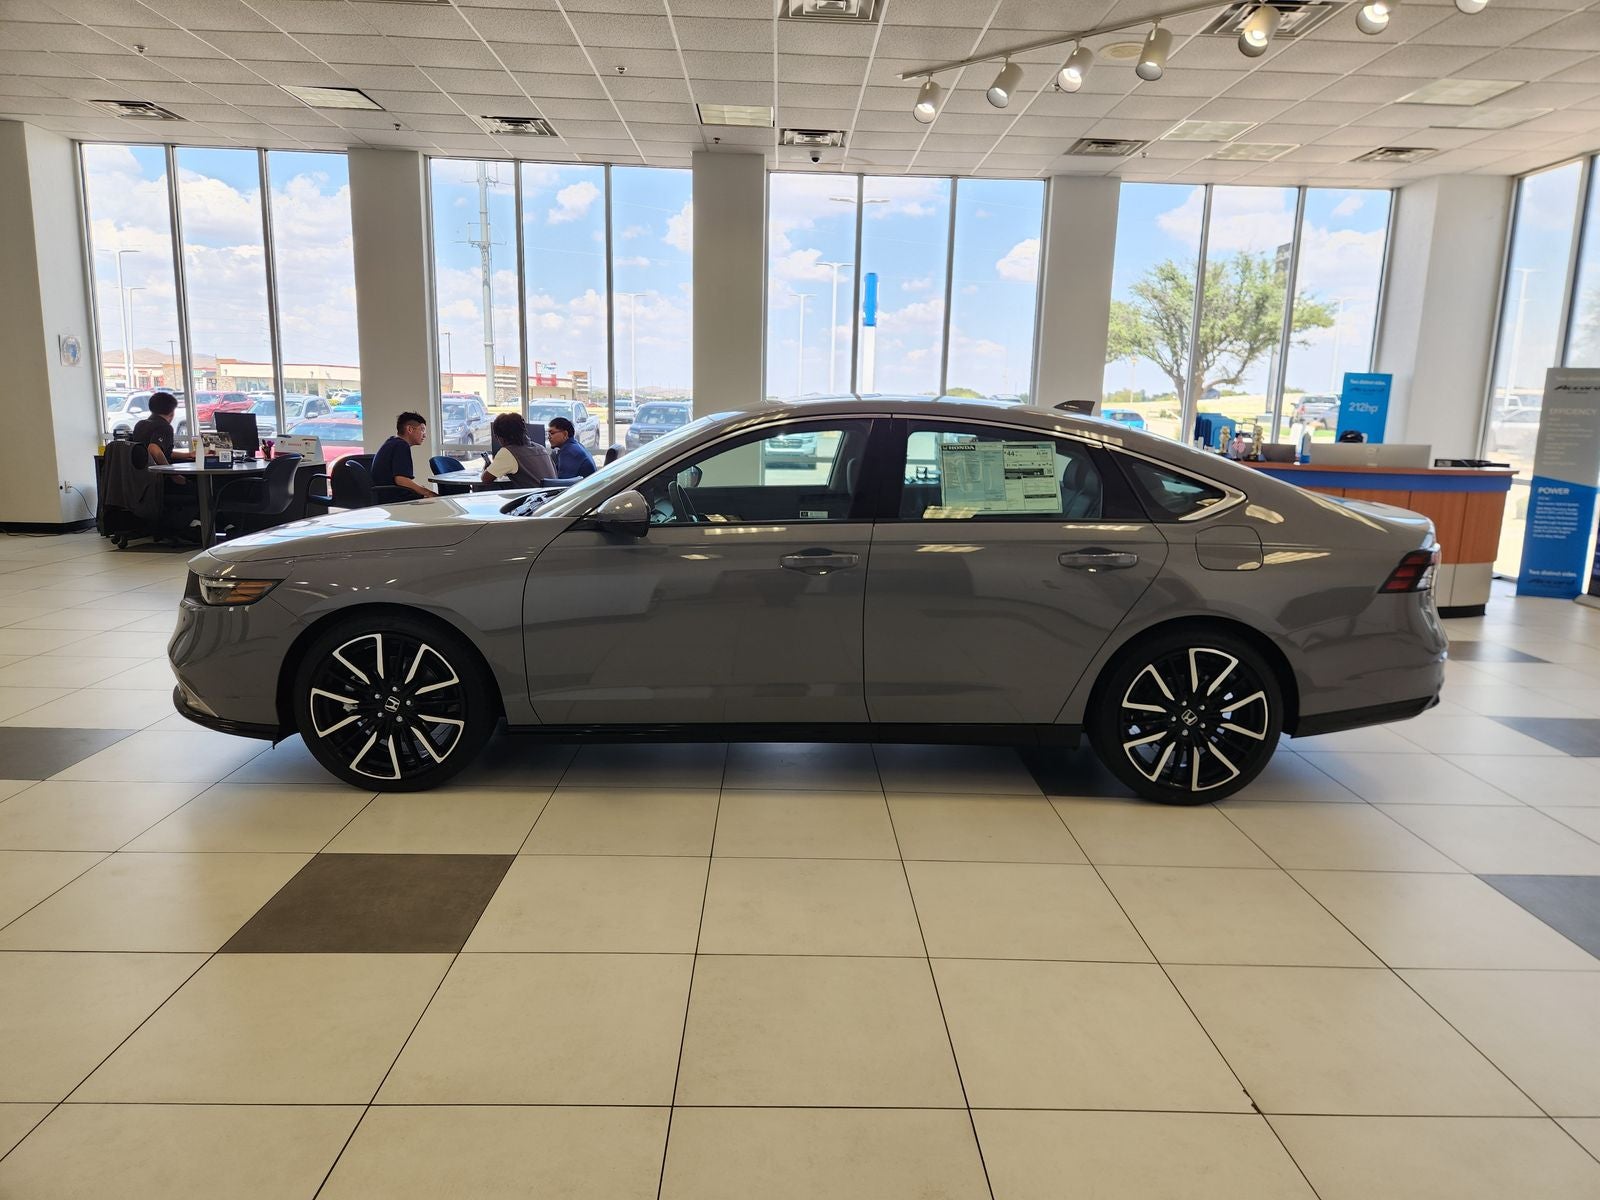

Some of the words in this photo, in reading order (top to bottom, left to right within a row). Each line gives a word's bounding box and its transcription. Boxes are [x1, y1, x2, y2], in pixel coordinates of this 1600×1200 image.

[1349, 402, 1378, 414] 212hp
[1549, 408, 1597, 416] EFFICIENCY
[1538, 486, 1570, 495] POWER
